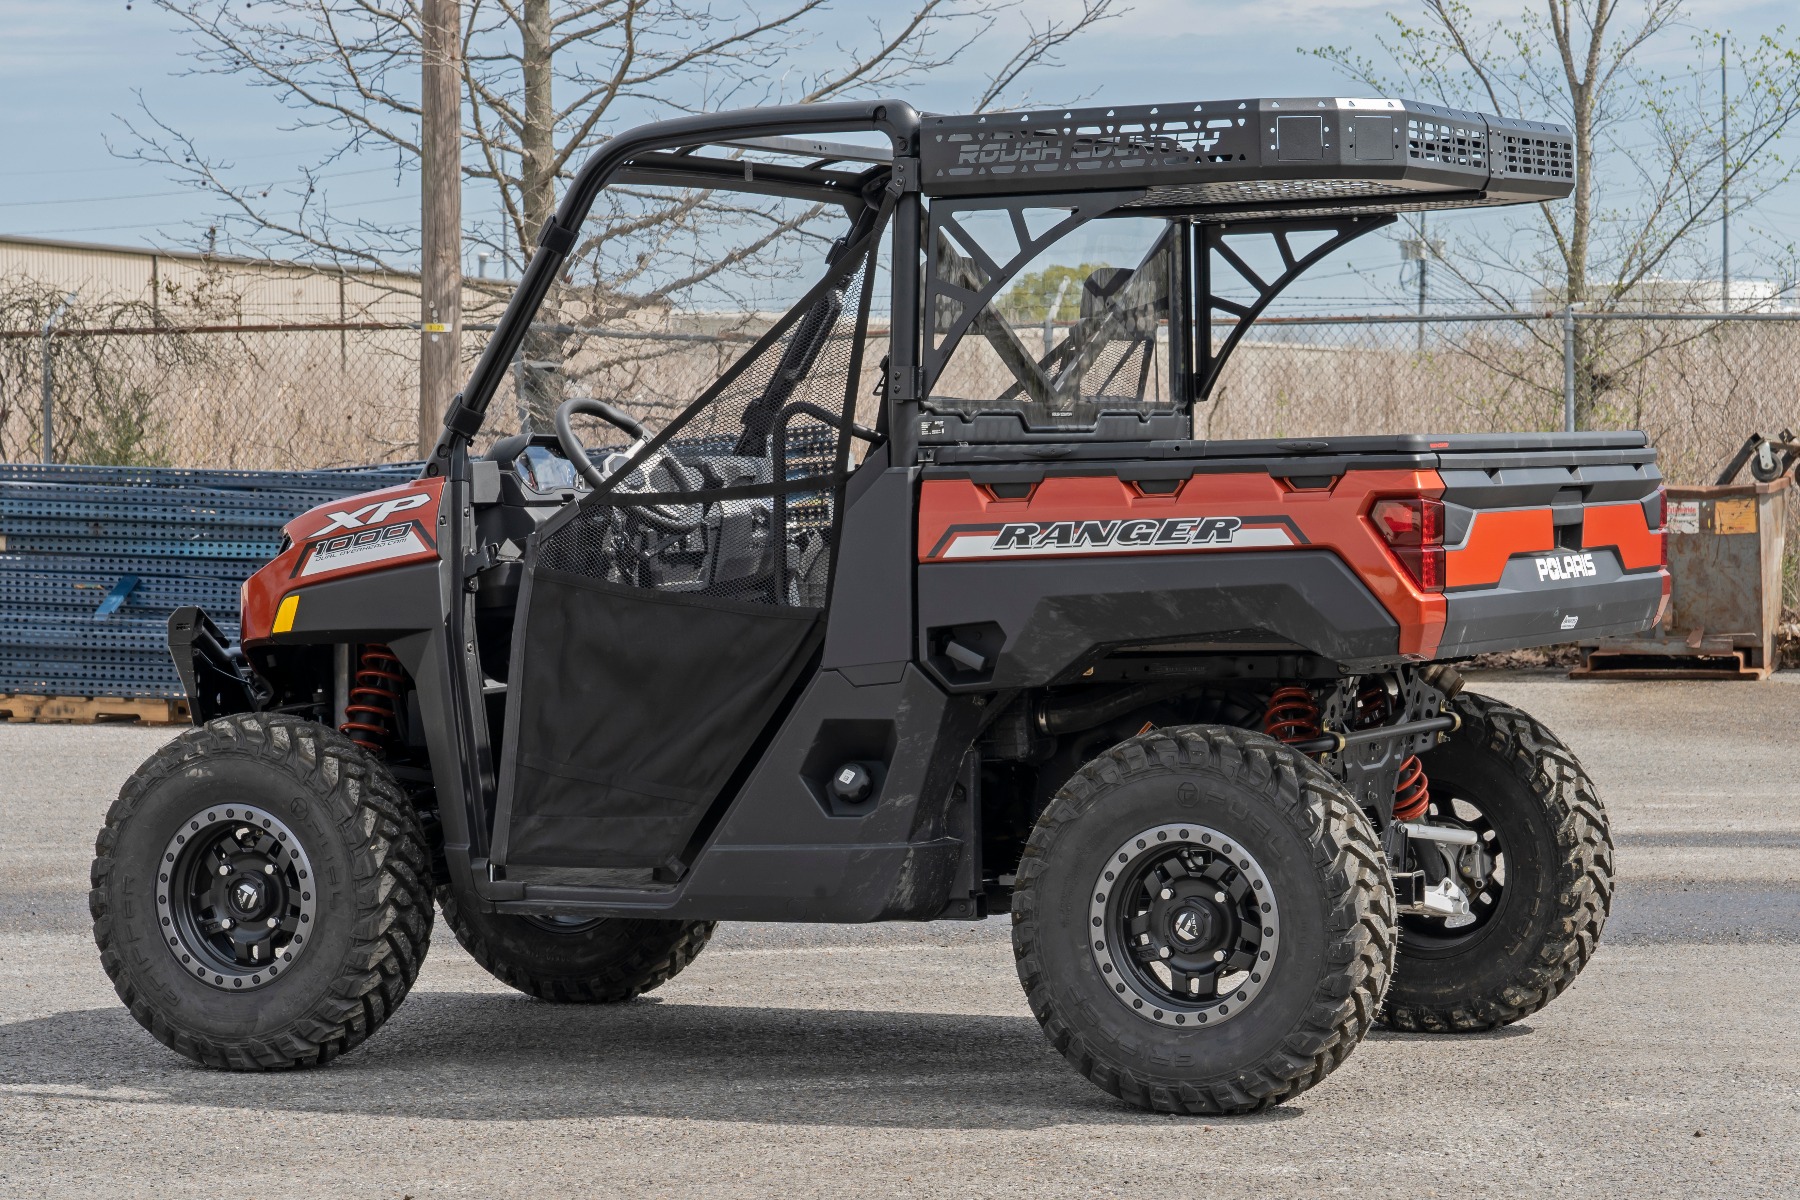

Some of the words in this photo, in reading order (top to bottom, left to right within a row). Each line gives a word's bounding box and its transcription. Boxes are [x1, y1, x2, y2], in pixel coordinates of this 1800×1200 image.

[958, 140, 1064, 165] ROUGH
[304, 492, 433, 540] XP
[314, 522, 413, 557] 1000
[992, 516, 1242, 550] RANGER
[315, 552, 337, 562] DUAL
[339, 543, 387, 556] OVERHEAD
[387, 538, 408, 546] CAM
[1535, 554, 1597, 582] POLARIS
